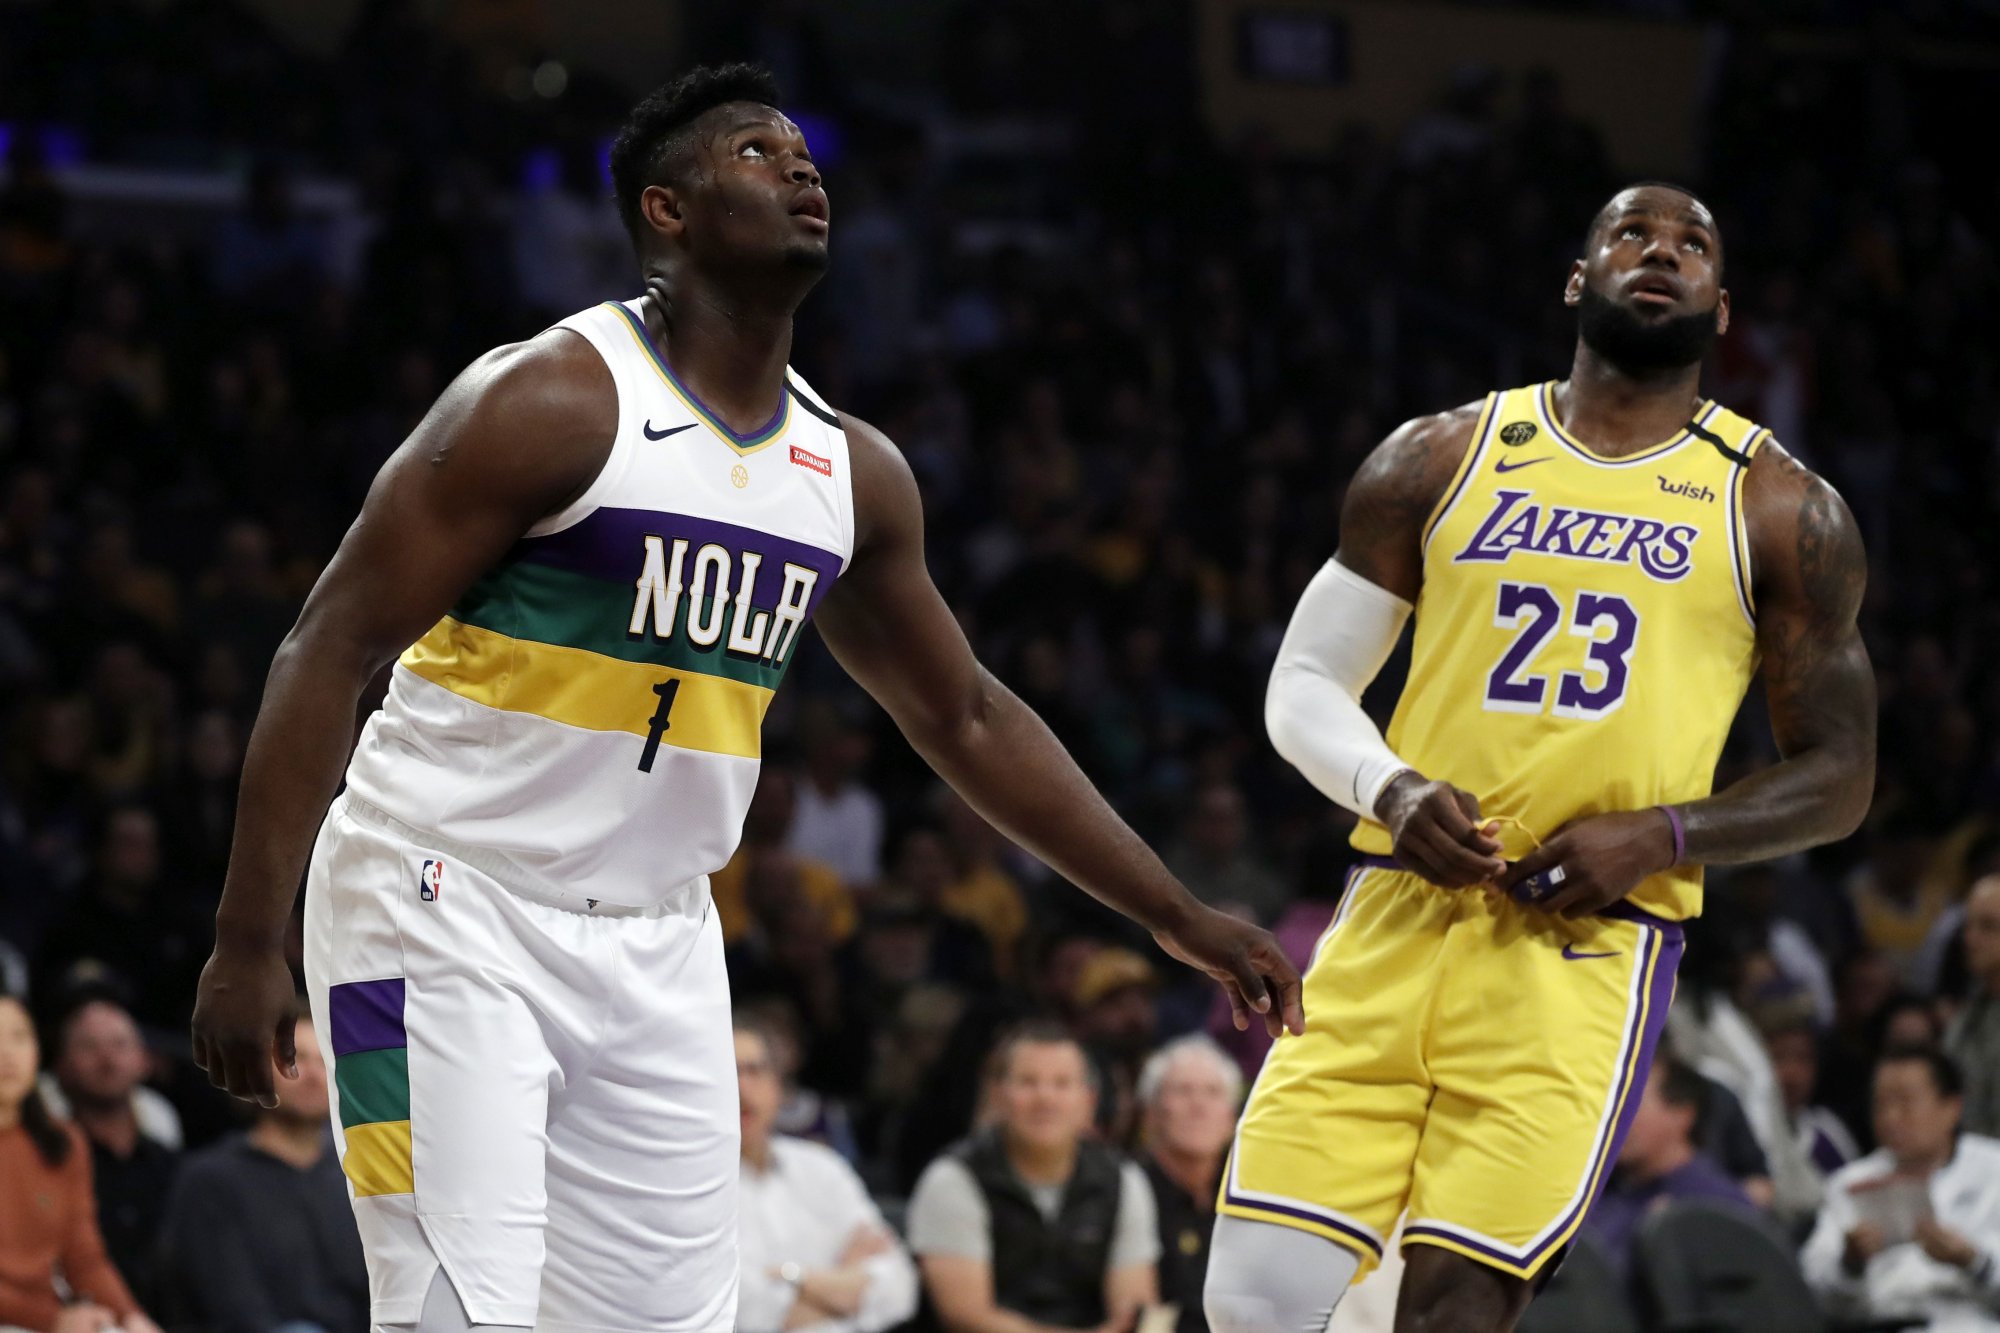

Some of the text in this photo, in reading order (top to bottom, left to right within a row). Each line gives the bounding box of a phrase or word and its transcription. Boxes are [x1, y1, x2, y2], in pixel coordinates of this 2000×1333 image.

[1452, 489, 1699, 583] LAKERS
[1657, 474, 1716, 504] wish
[627, 535, 819, 666] NOLA
[1482, 581, 1640, 721] 23
[637, 678, 680, 774] 1
